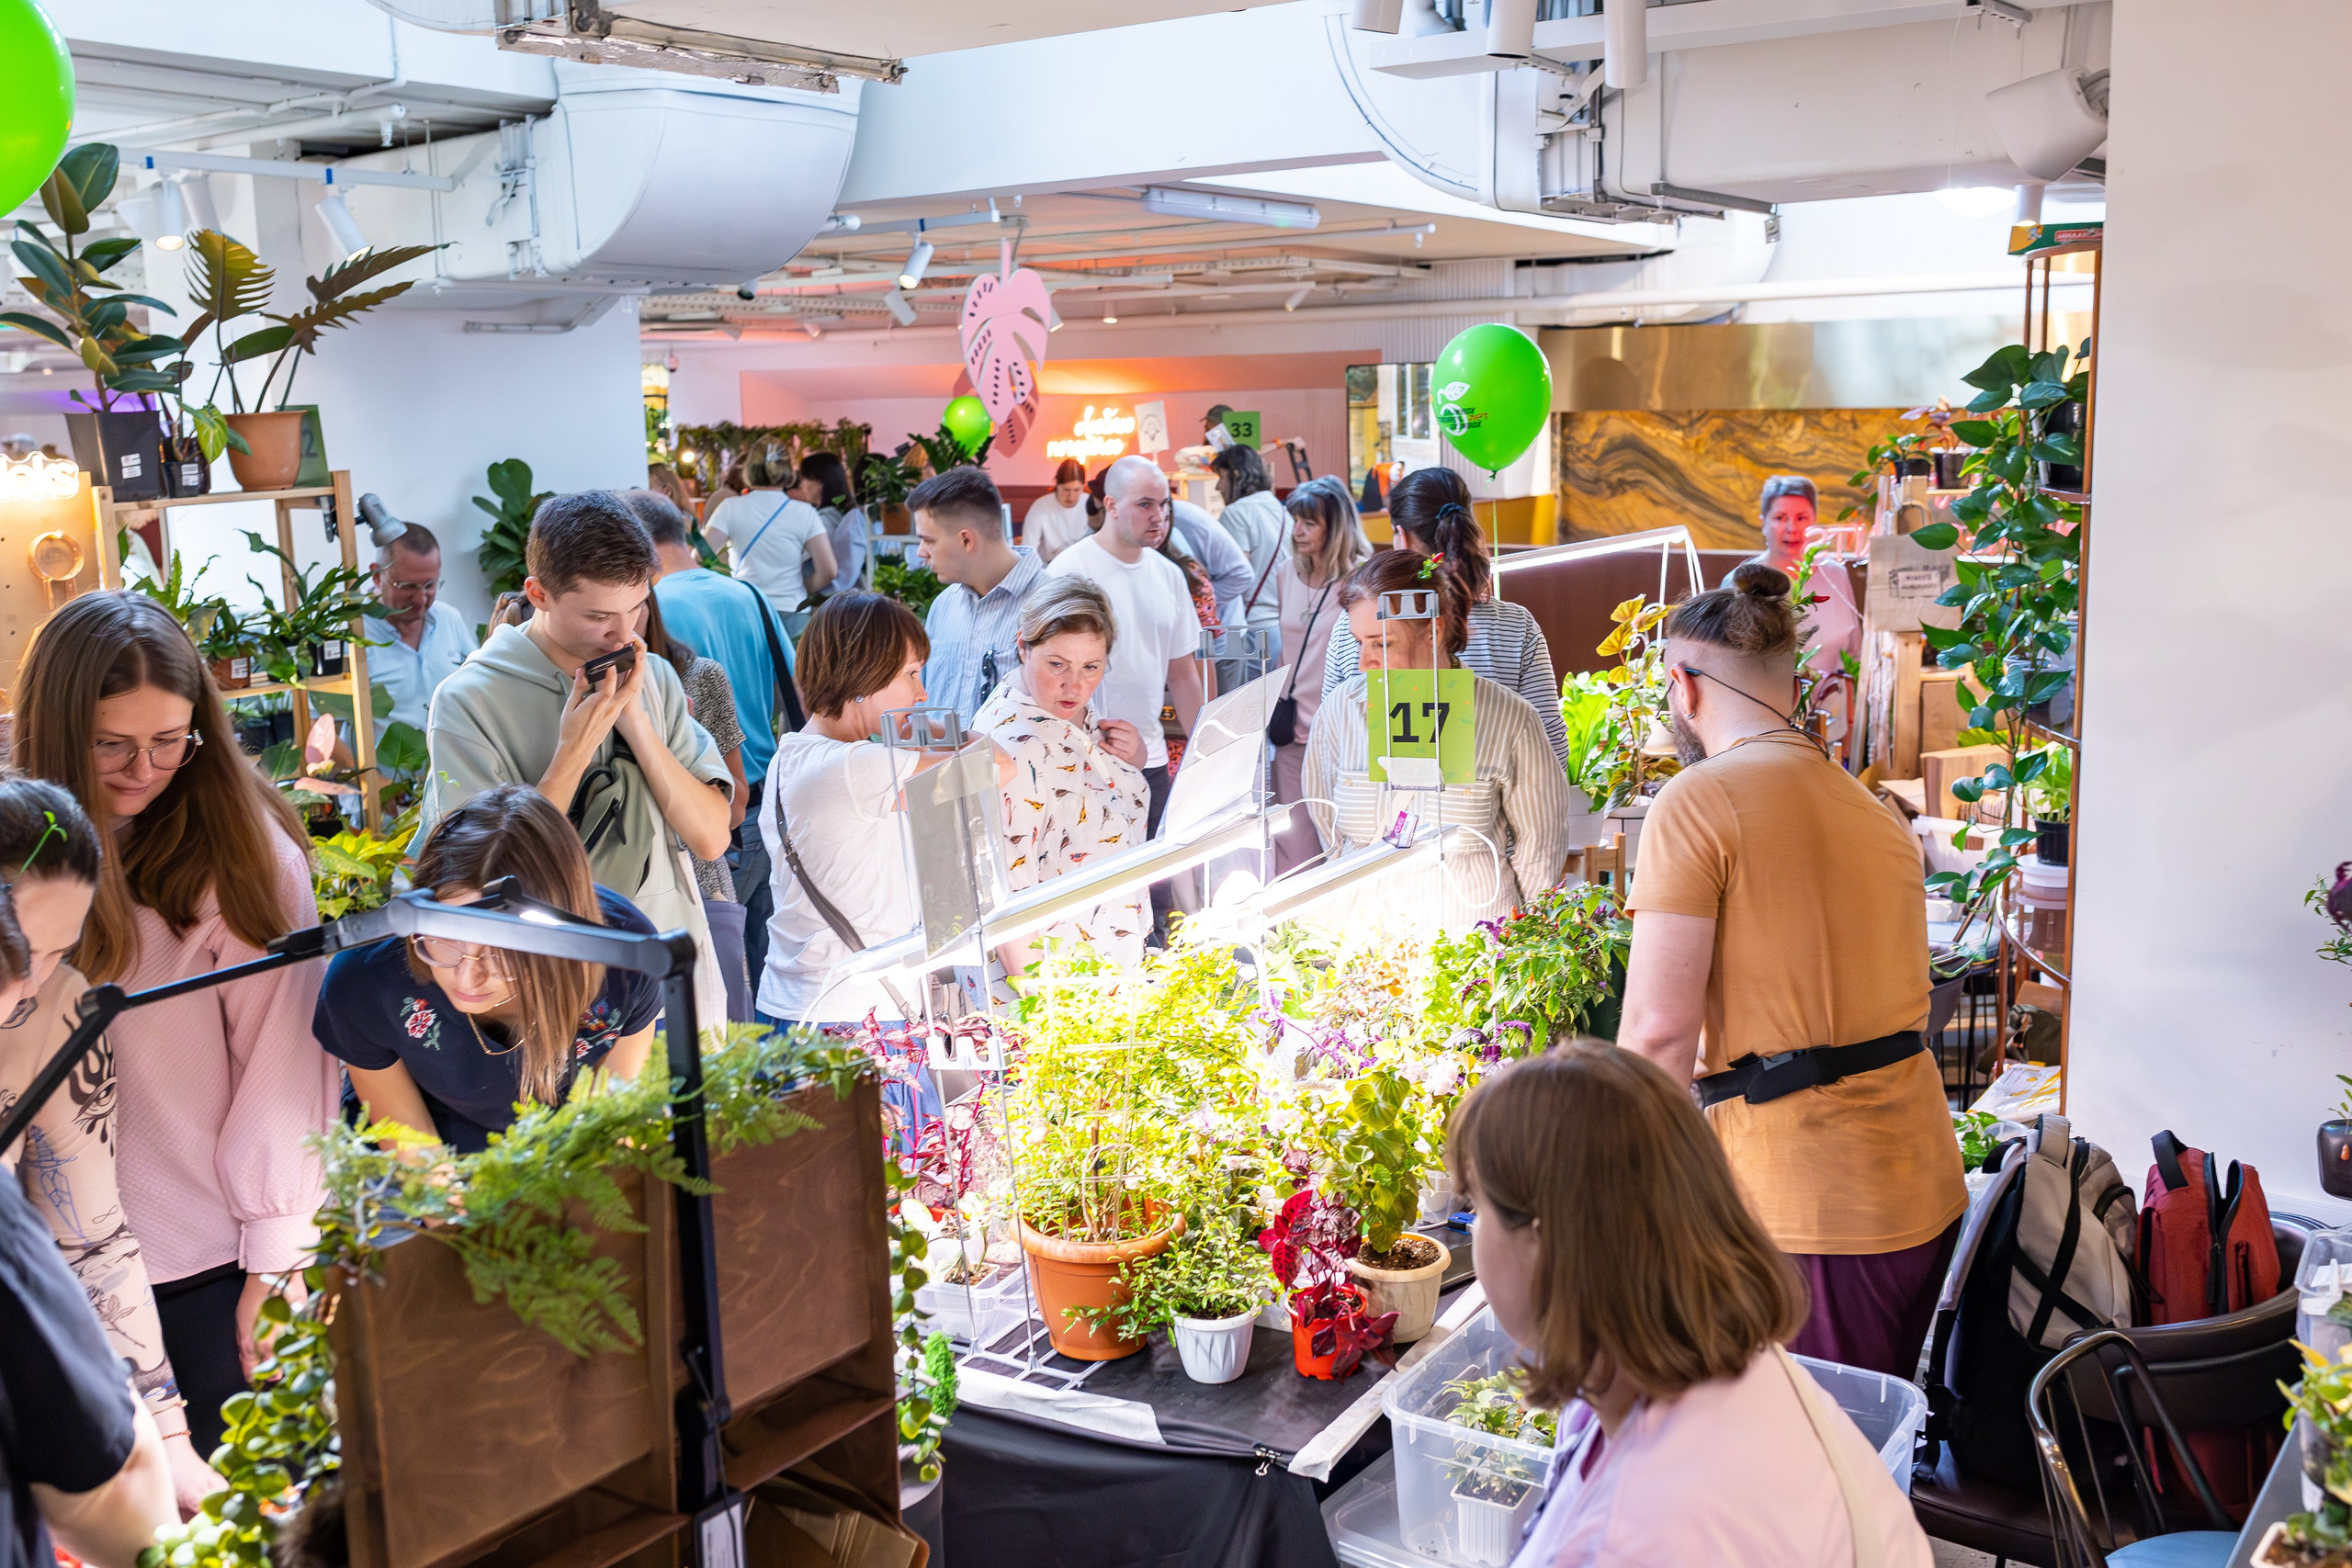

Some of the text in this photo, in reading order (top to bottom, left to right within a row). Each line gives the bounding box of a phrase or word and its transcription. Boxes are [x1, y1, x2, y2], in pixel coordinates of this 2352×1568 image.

[300, 428, 319, 457] 2
[1231, 422, 1252, 437] 33
[1389, 702, 1451, 743] 17
